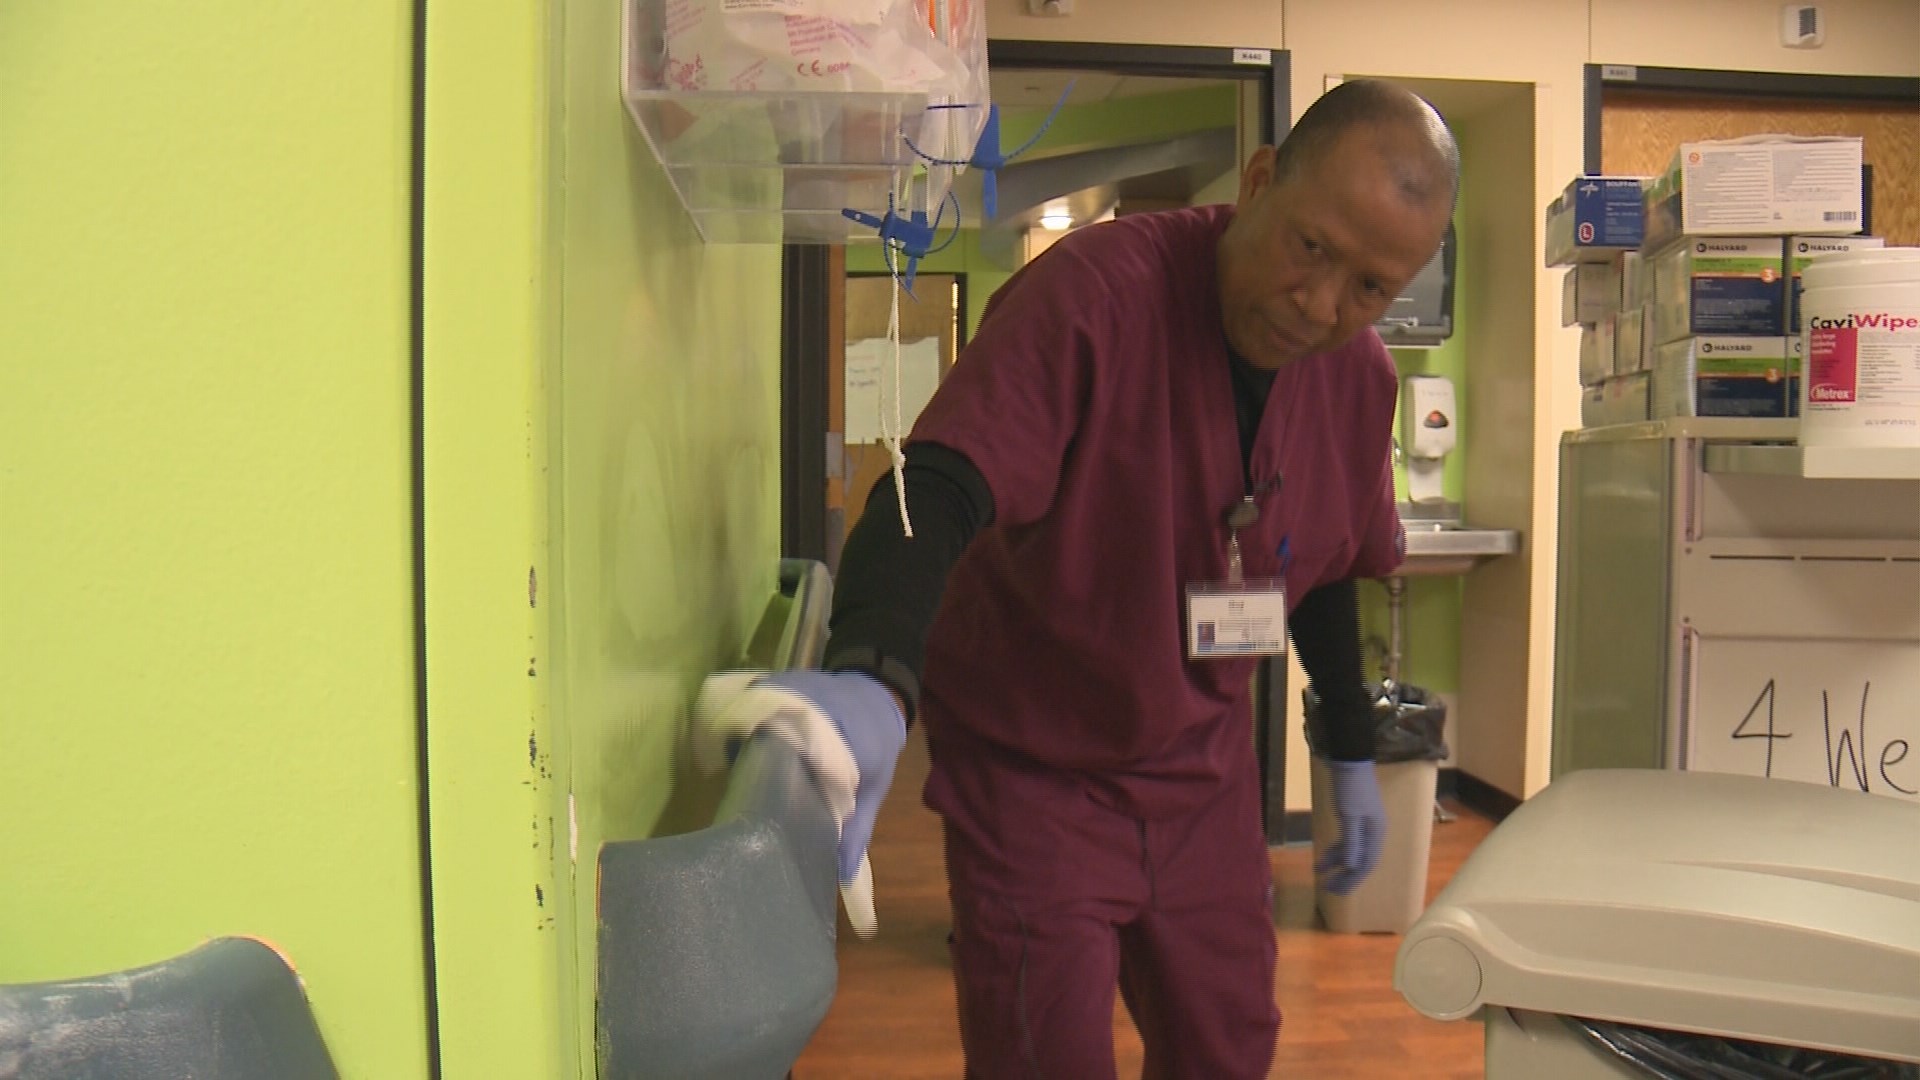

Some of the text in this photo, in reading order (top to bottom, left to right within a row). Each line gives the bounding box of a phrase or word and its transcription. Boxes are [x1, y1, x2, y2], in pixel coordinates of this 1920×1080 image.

[1582, 224, 1591, 239] L
[1810, 244, 1849, 252] HALYARD
[1810, 313, 1920, 331] CaviWipe
[1714, 344, 1753, 352] HALYARD
[1816, 386, 1849, 399] Metrex
[1731, 677, 1919, 795] 4 We
